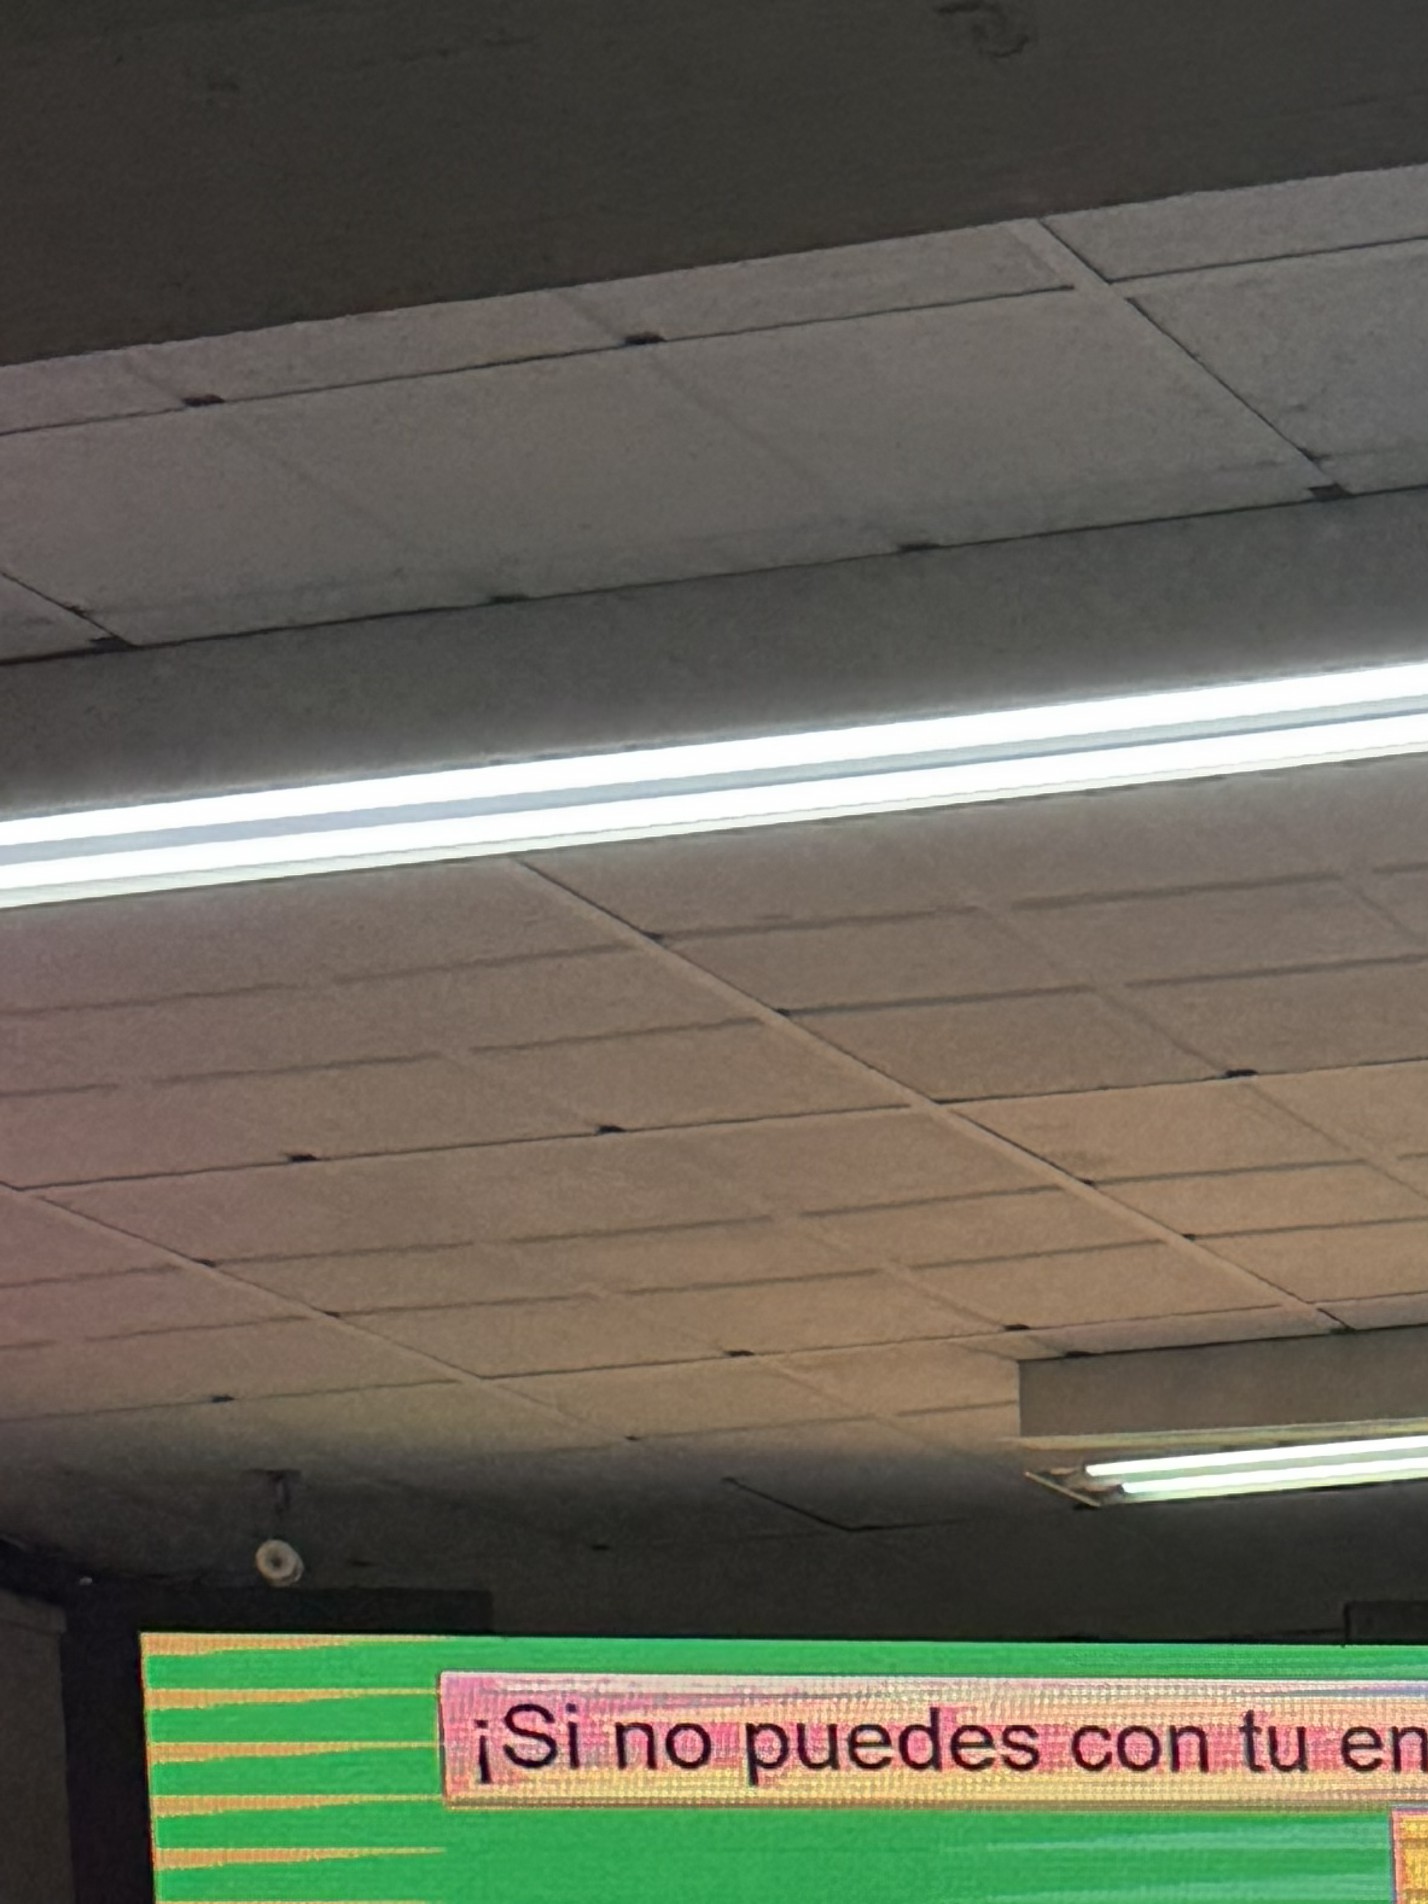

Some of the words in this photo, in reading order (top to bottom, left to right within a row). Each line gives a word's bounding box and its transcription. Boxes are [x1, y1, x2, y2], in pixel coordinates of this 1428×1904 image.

[475, 1702, 579, 1783] ¡Si
[615, 1719, 711, 1772] no
[747, 1708, 1041, 1788] puedes
[1072, 1722, 1207, 1772] con
[1243, 1709, 1306, 1773] tu
